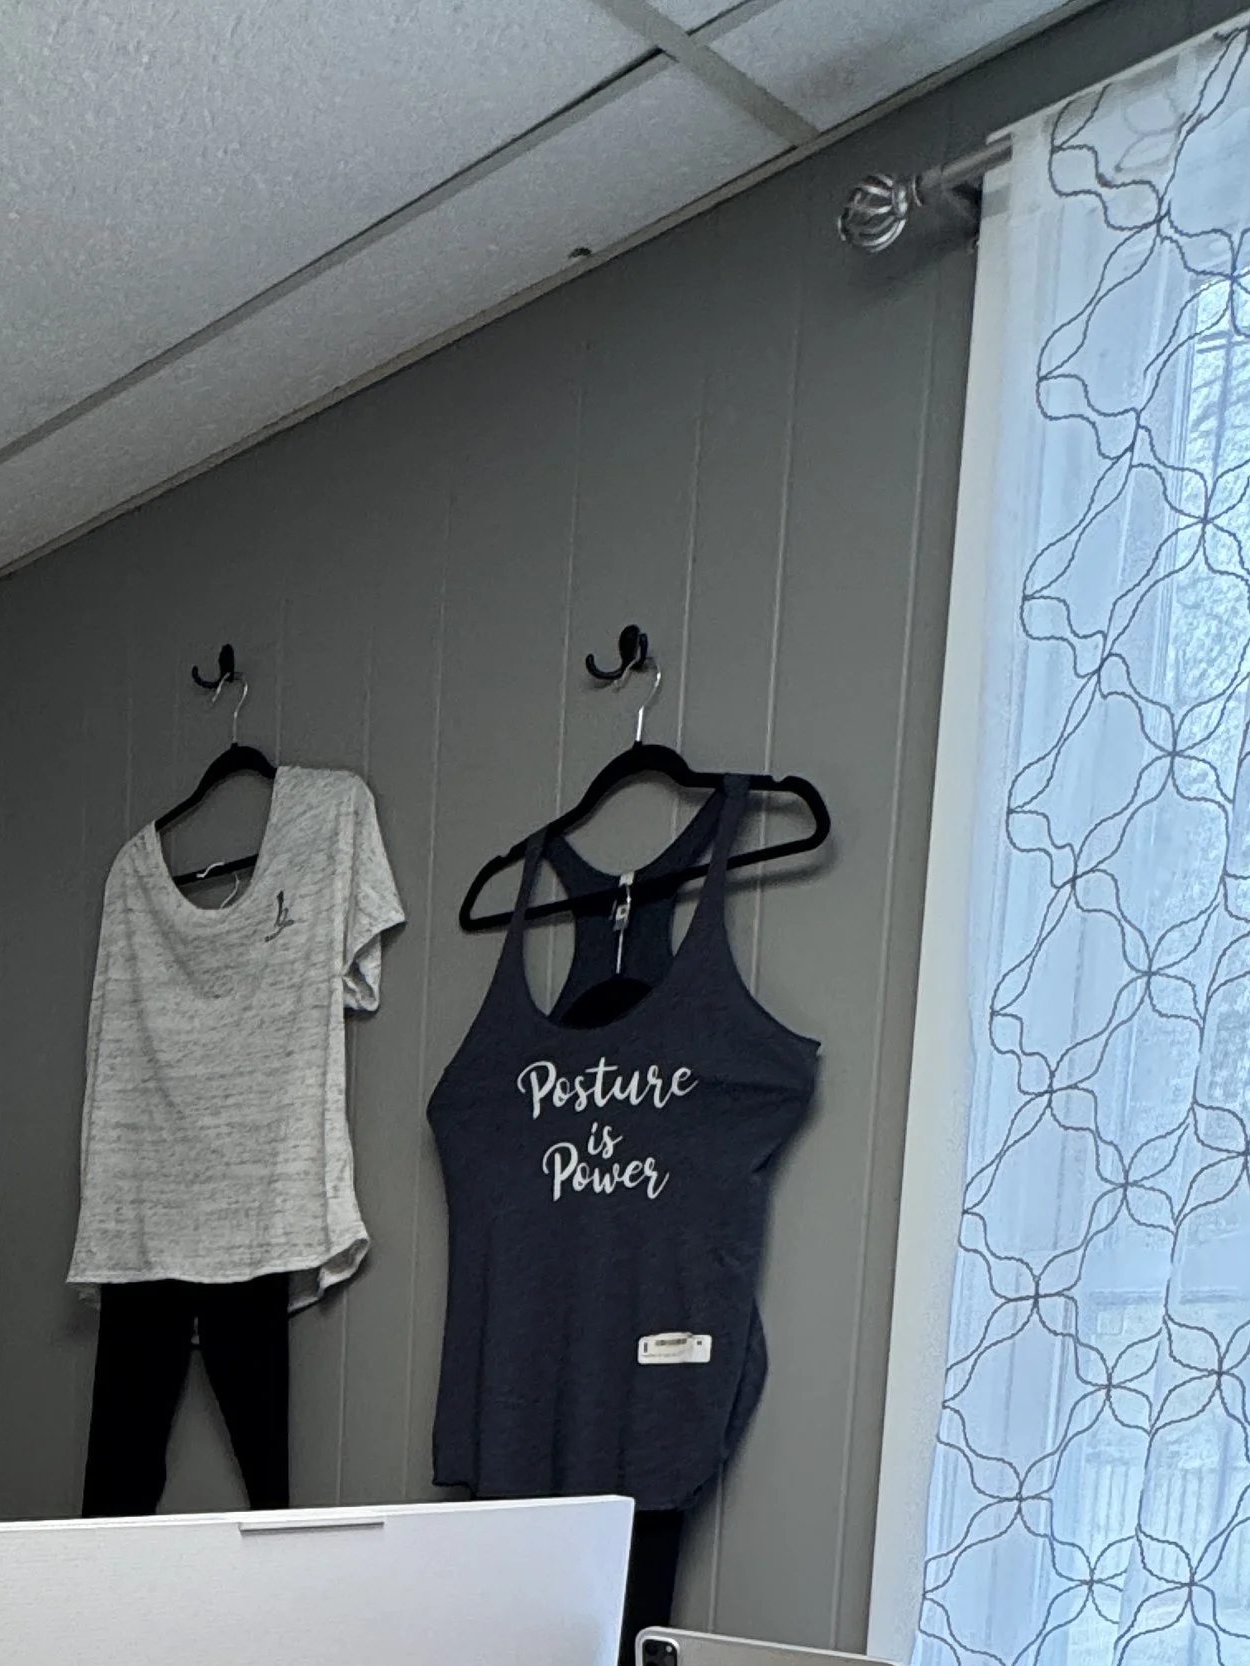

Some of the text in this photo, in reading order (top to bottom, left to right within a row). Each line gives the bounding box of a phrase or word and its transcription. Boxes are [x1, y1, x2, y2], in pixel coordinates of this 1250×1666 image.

[517, 1057, 699, 1120] Posture
[587, 1121, 623, 1159] is
[542, 1142, 669, 1202] Power
